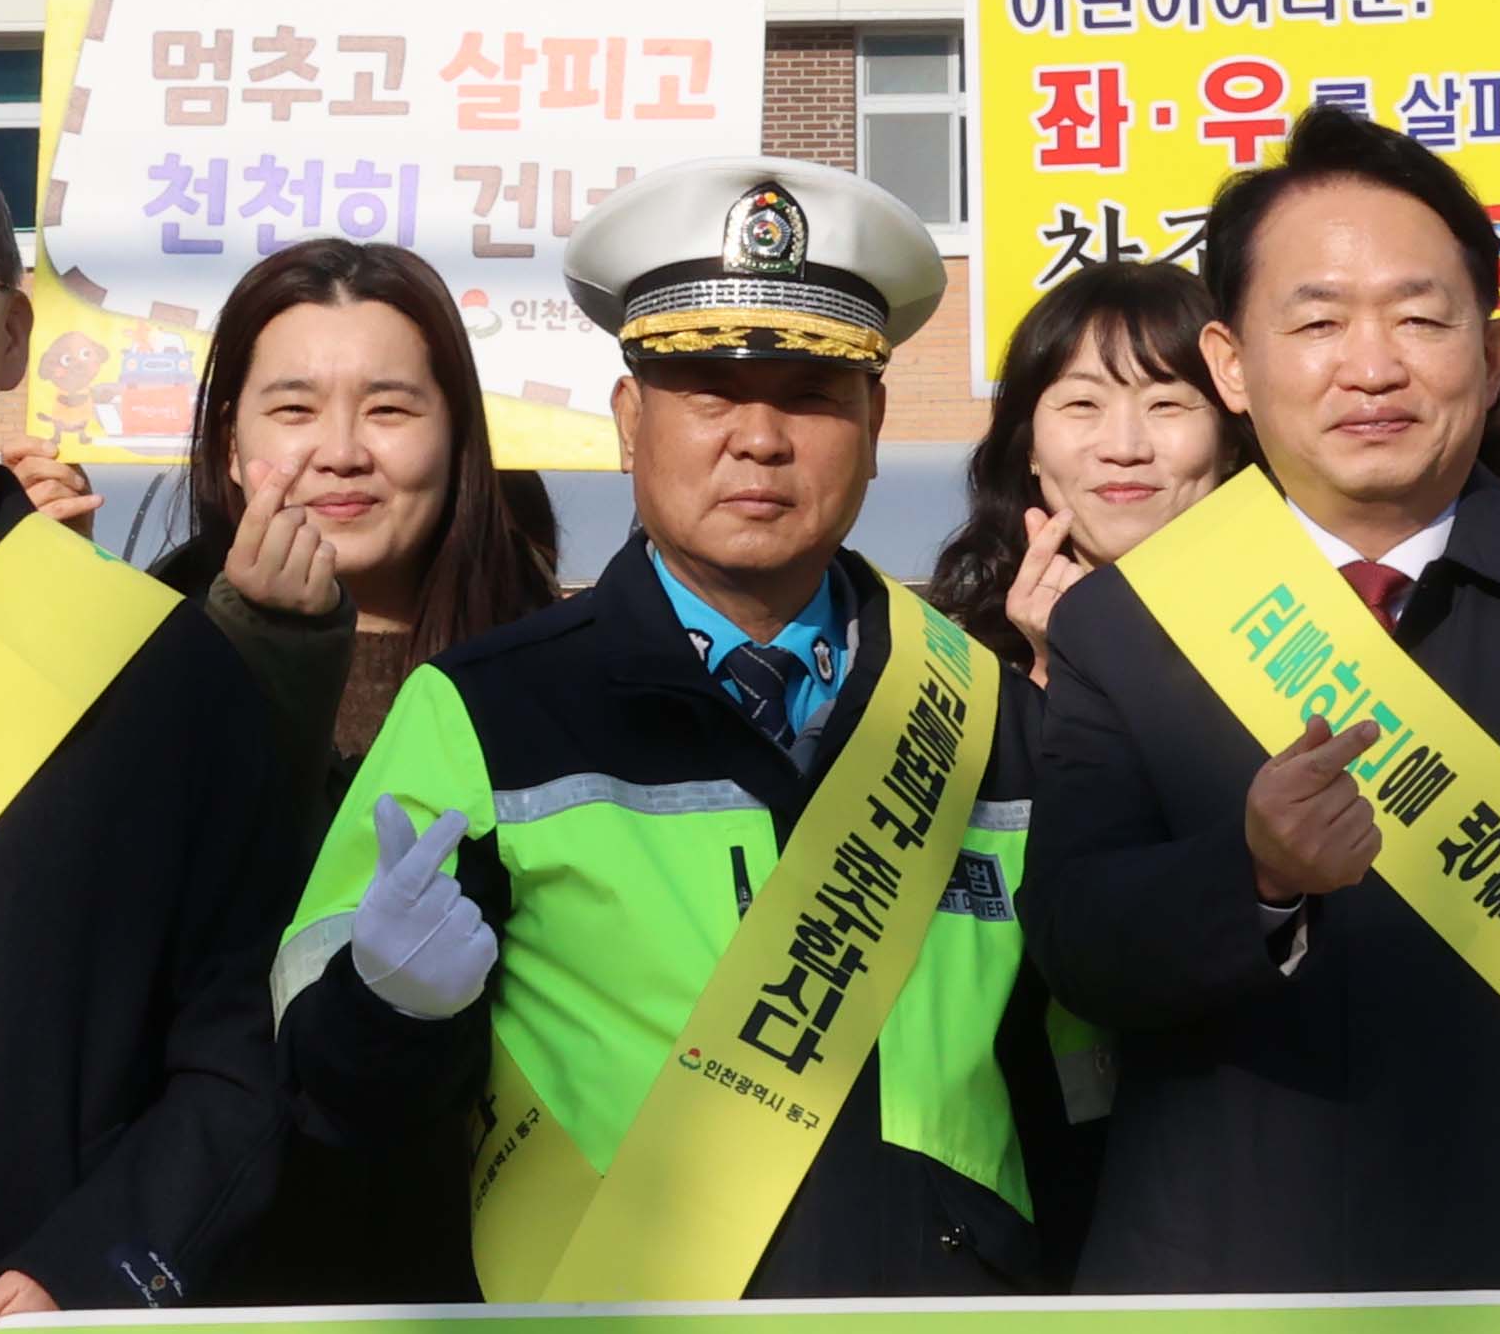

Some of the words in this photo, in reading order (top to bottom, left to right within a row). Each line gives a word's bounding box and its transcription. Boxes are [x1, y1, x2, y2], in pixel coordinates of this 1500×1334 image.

[152, 24, 411, 127] 멈추고
[438, 28, 717, 131] 살피고
[142, 152, 420, 256] 천천히
[453, 159, 637, 259] 건너
[866, 660, 967, 851] 교통법규
[738, 830, 904, 1077] 준수합시다
[703, 1057, 785, 1113] 인천광역시
[785, 1100, 821, 1132] 동구
